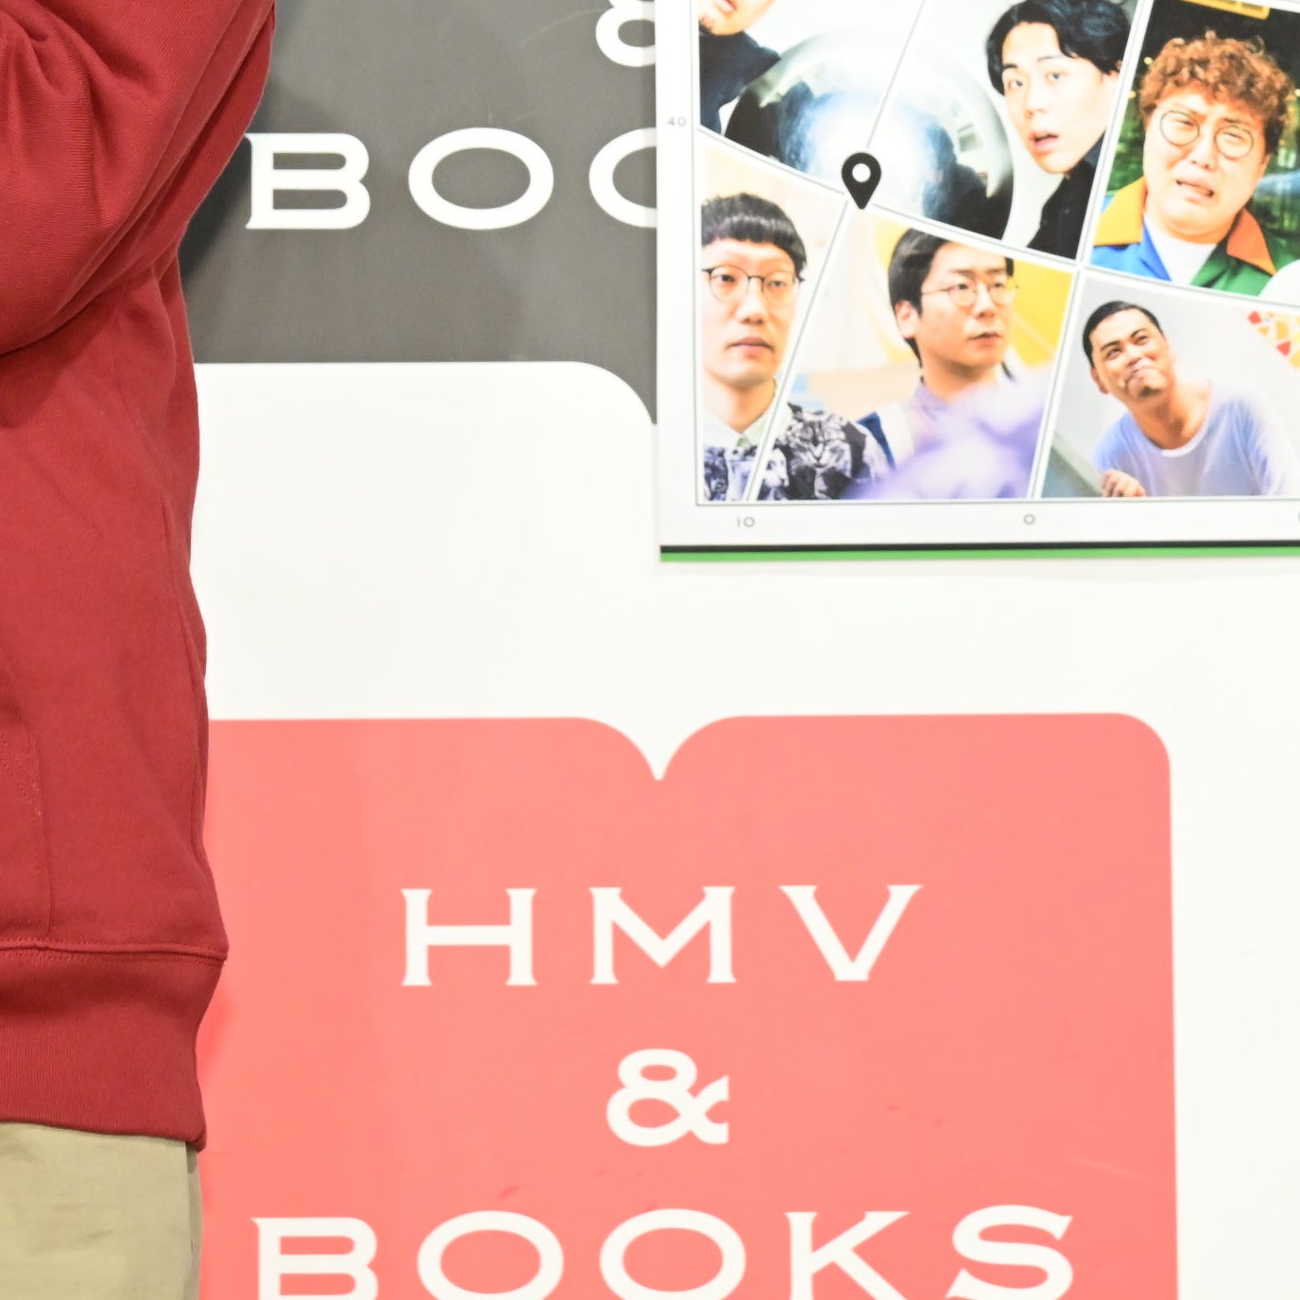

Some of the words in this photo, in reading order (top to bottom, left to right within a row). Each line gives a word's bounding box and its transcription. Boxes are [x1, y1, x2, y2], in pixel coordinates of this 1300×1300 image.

[400, 884, 924, 987] HMV
[606, 1048, 730, 1147] &
[251, 1203, 1075, 1300] BOOKS
